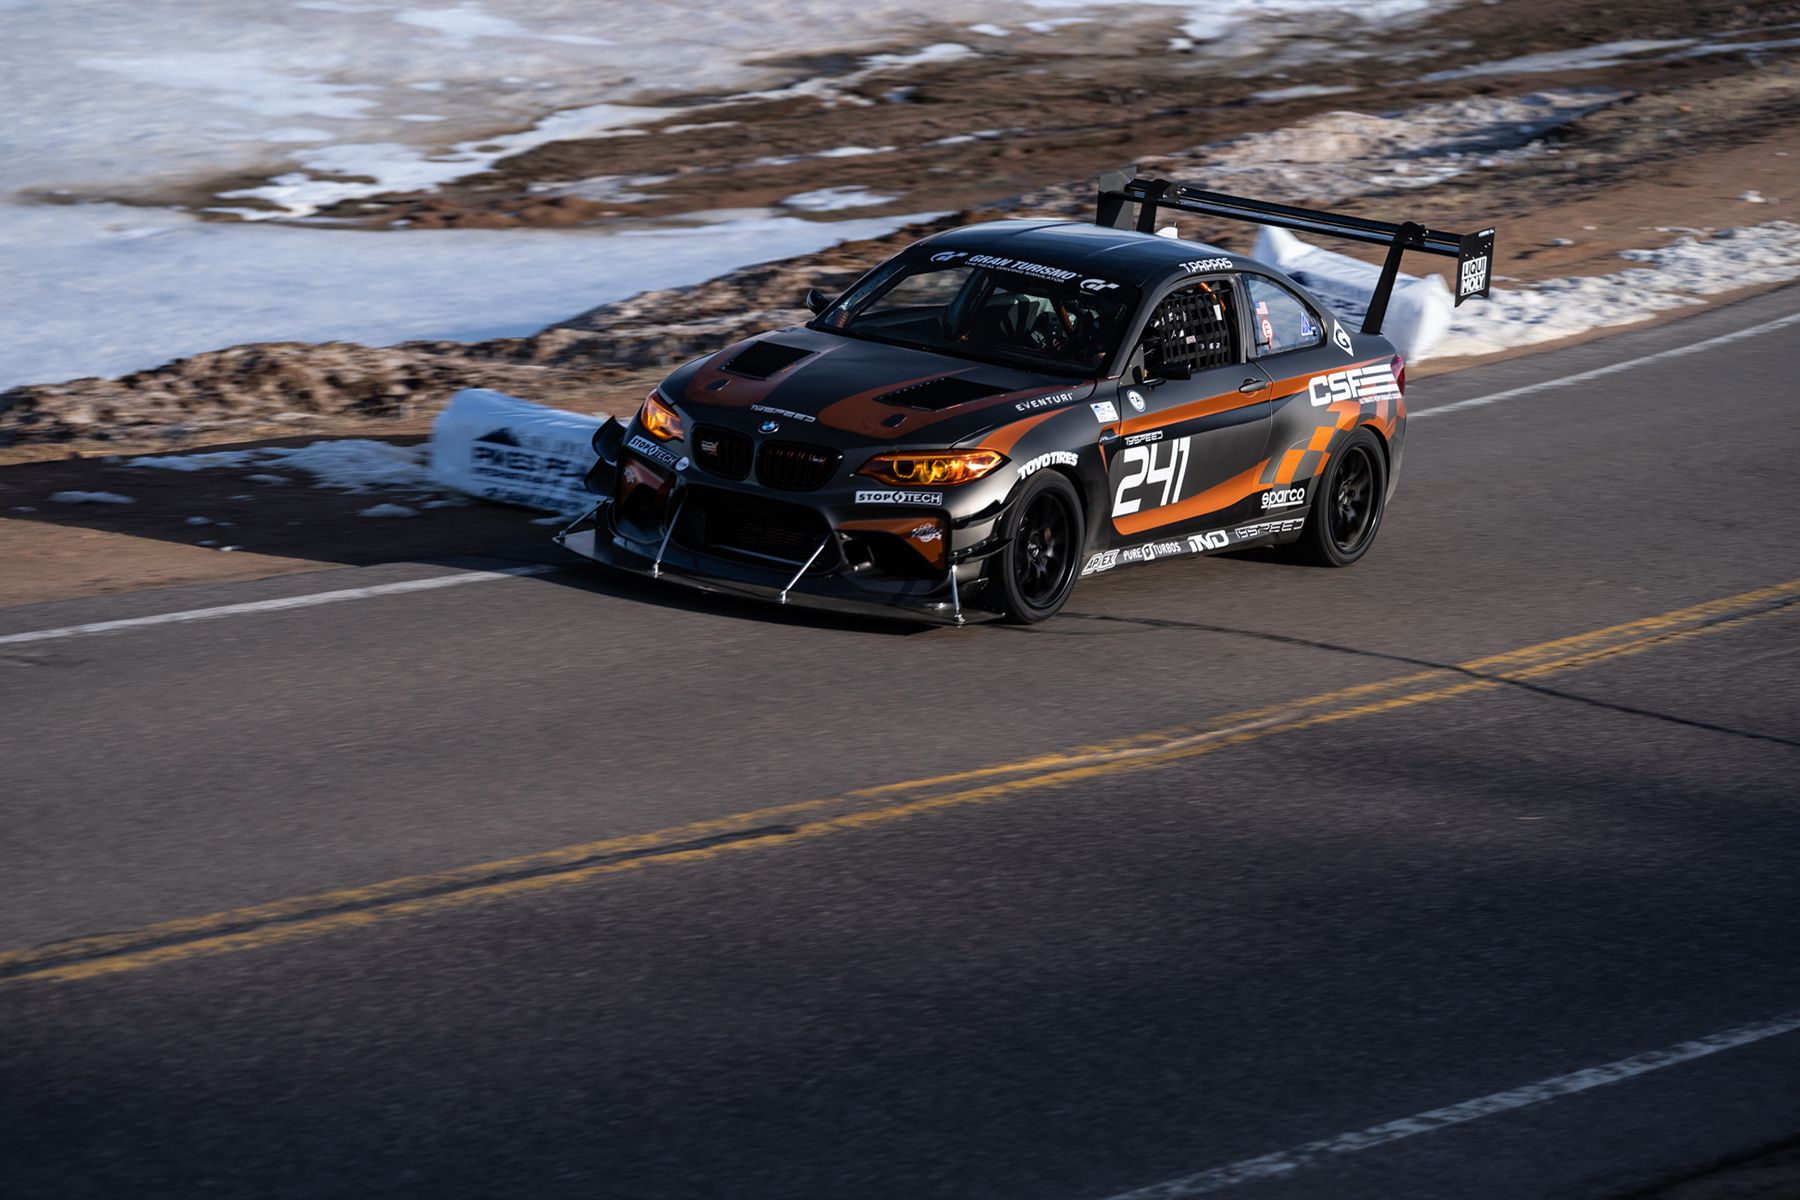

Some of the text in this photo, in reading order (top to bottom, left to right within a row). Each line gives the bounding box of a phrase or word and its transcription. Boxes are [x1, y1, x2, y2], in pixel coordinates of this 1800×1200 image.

[969, 254, 1077, 280] GRAN TURISMO
[996, 265, 1024, 274] DRIVING
[1024, 270, 1065, 283] SIMULATOR
[1463, 258, 1486, 277] LIQUI
[1461, 274, 1485, 294] MOLY
[1308, 363, 1400, 407] CSF
[1015, 392, 1073, 411] EVENTURI
[1112, 436, 1191, 518] 241
[1261, 487, 1305, 509] sparco
[1123, 541, 1182, 561] PURE TURBOS
